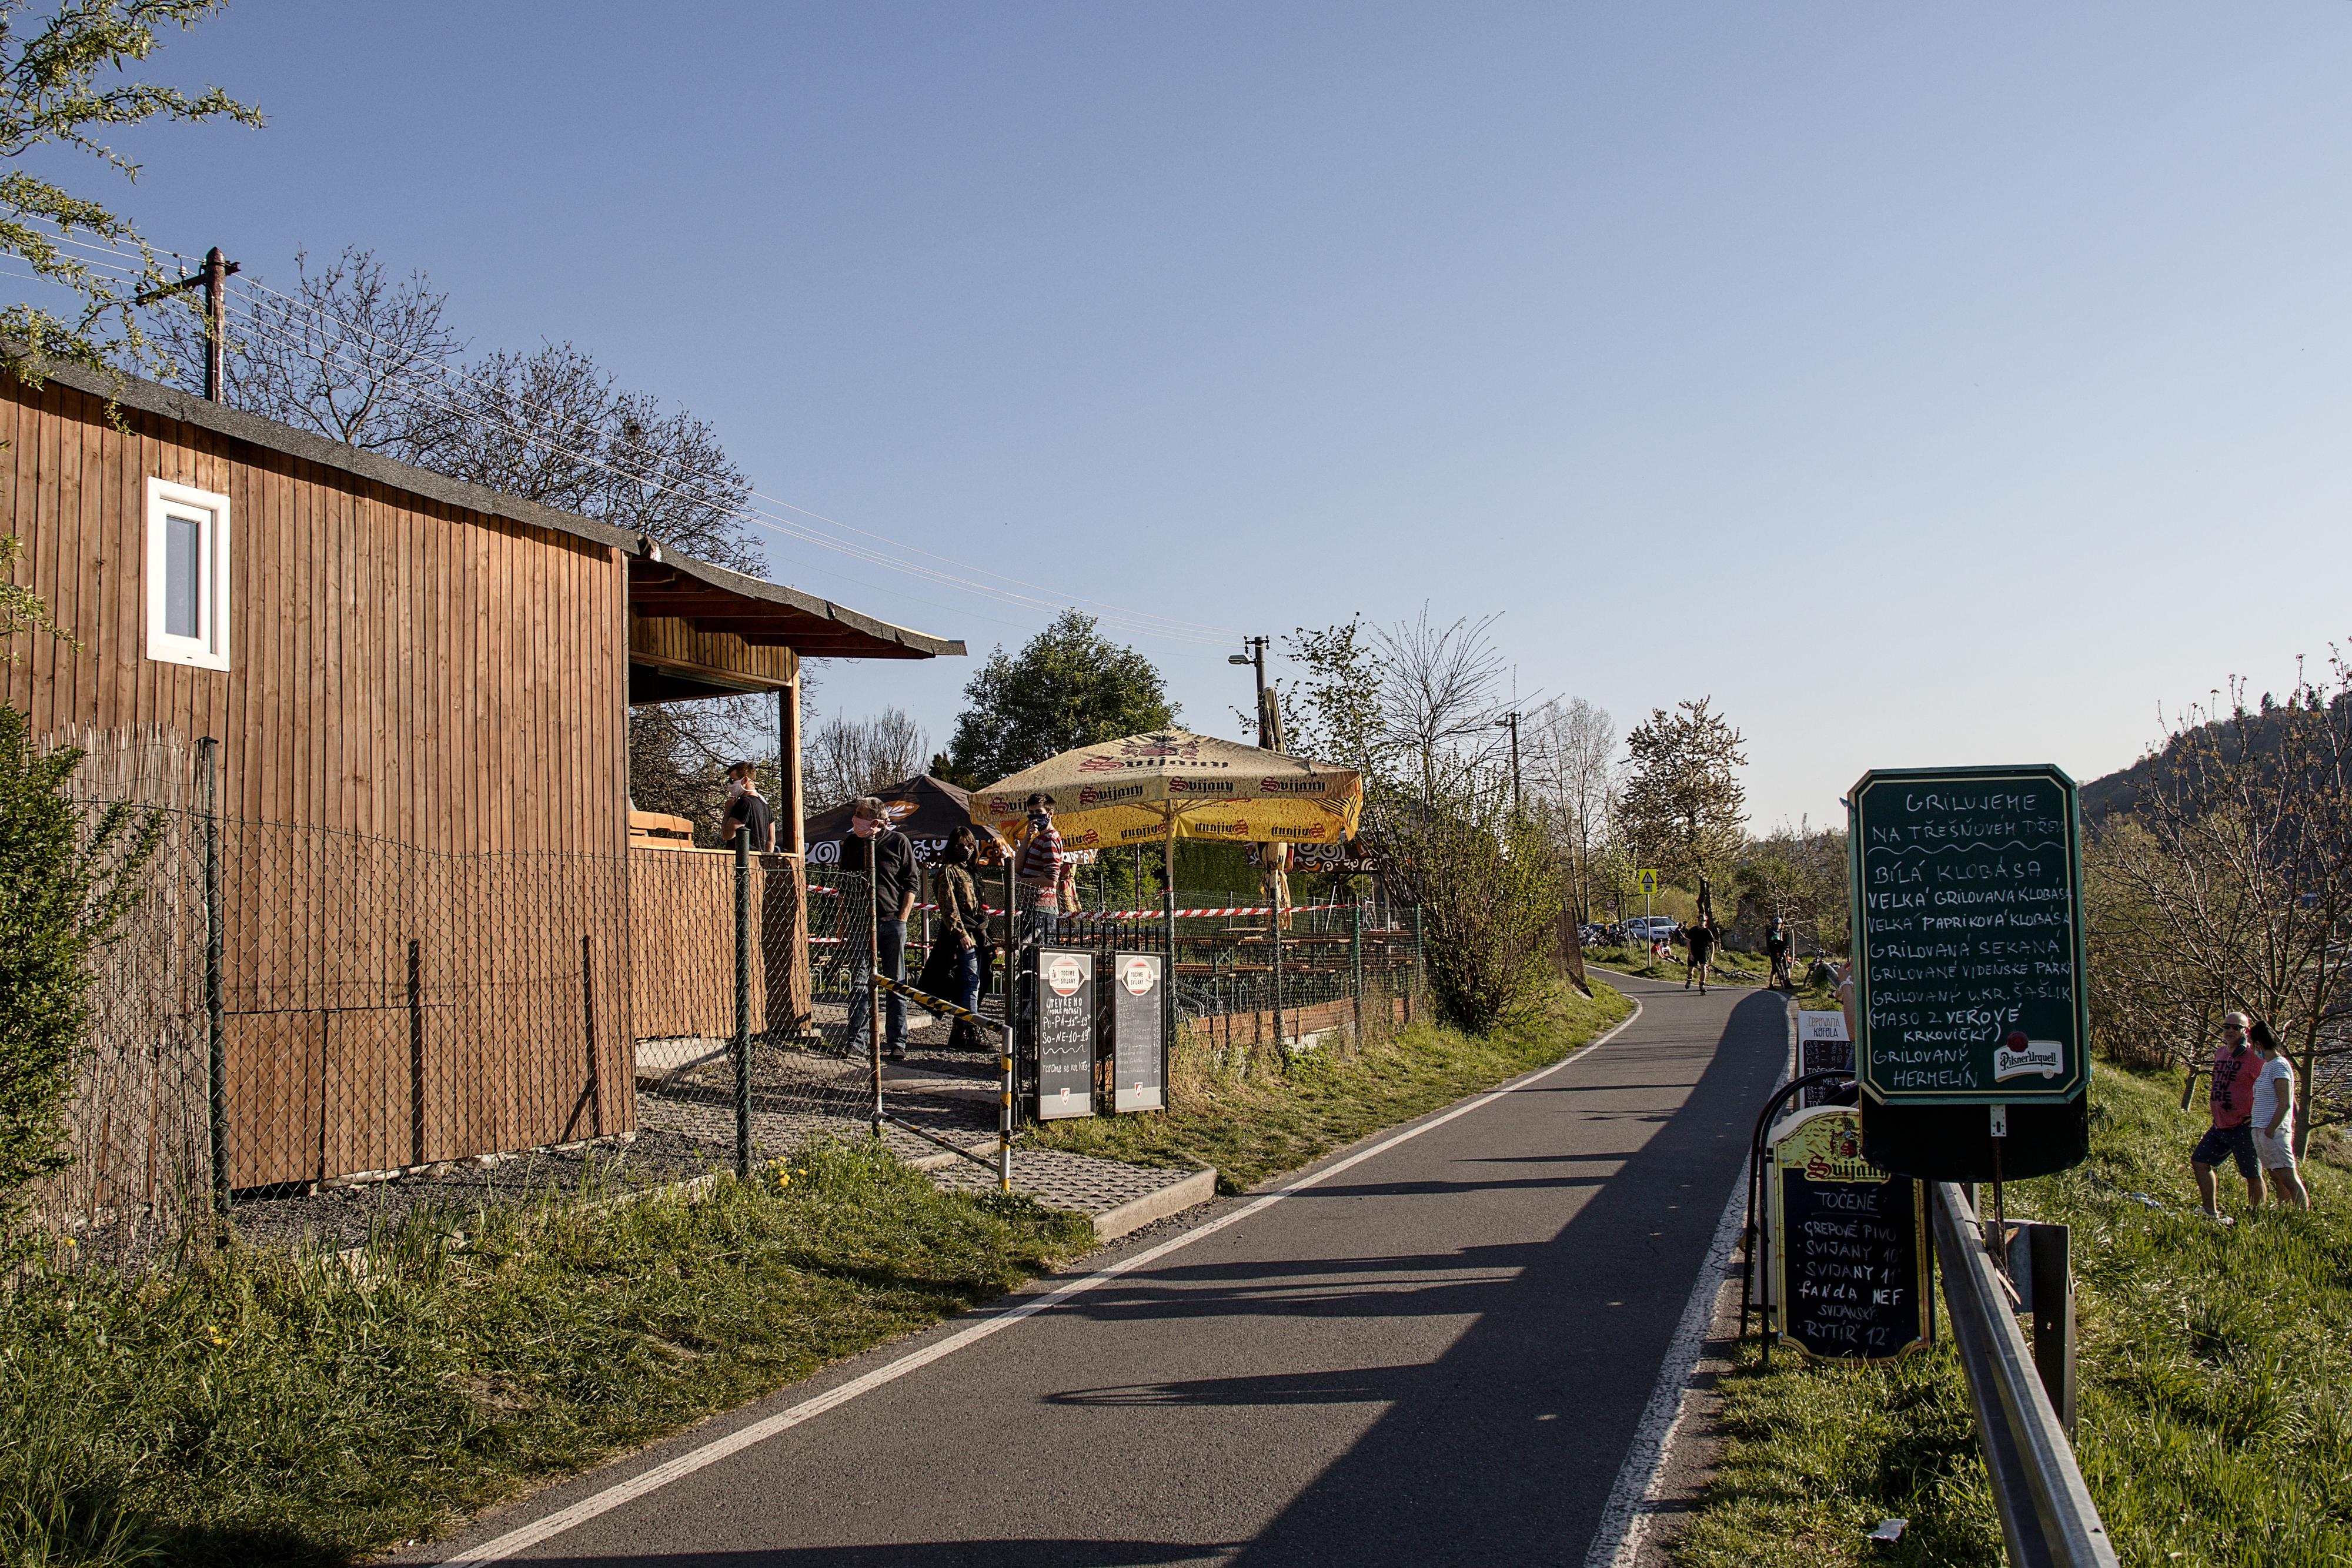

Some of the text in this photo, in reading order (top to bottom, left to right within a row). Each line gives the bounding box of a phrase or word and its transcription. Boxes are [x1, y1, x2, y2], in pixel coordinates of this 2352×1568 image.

[1168, 776, 1234, 793] Svijany
[1260, 777, 1325, 793] Svijany
[989, 797, 1027, 815] Svij
[1078, 785, 1144, 811] Svijany
[1873, 827, 1900, 842] NA
[1874, 856, 2042, 884] BÍLÁ KLOBÁSA
[1868, 877, 2072, 909] VELKÁ GRILOVANÁ KLOBÁSA
[1867, 905, 2071, 934] VELKÁ PAPRIKOVÁ KLOBÁSA
[1870, 930, 2060, 958] GRILOVANÁ SEKANÁ
[1872, 960, 1957, 982] GRILOVANÉ
[1872, 984, 1962, 1006] GRILOVANÝ
[2013, 979, 2072, 1002] ŠAŠLIK
[1869, 1007, 1920, 1029] (MASO
[1946, 1003, 2023, 1027] VEŘOVÉ
[1813, 1028, 1839, 1038] KOFOLA
[1872, 1044, 1969, 1065] GRILOVANÝ
[1999, 1051, 2058, 1071] Pilsner Urquell
[1893, 1062, 1978, 1088] HERMELÍN
[1806, 1152, 1889, 1181] Svijany
[1806, 1239, 1872, 1261] SVIJANY
[1805, 1261, 1874, 1281] SVIJANY
